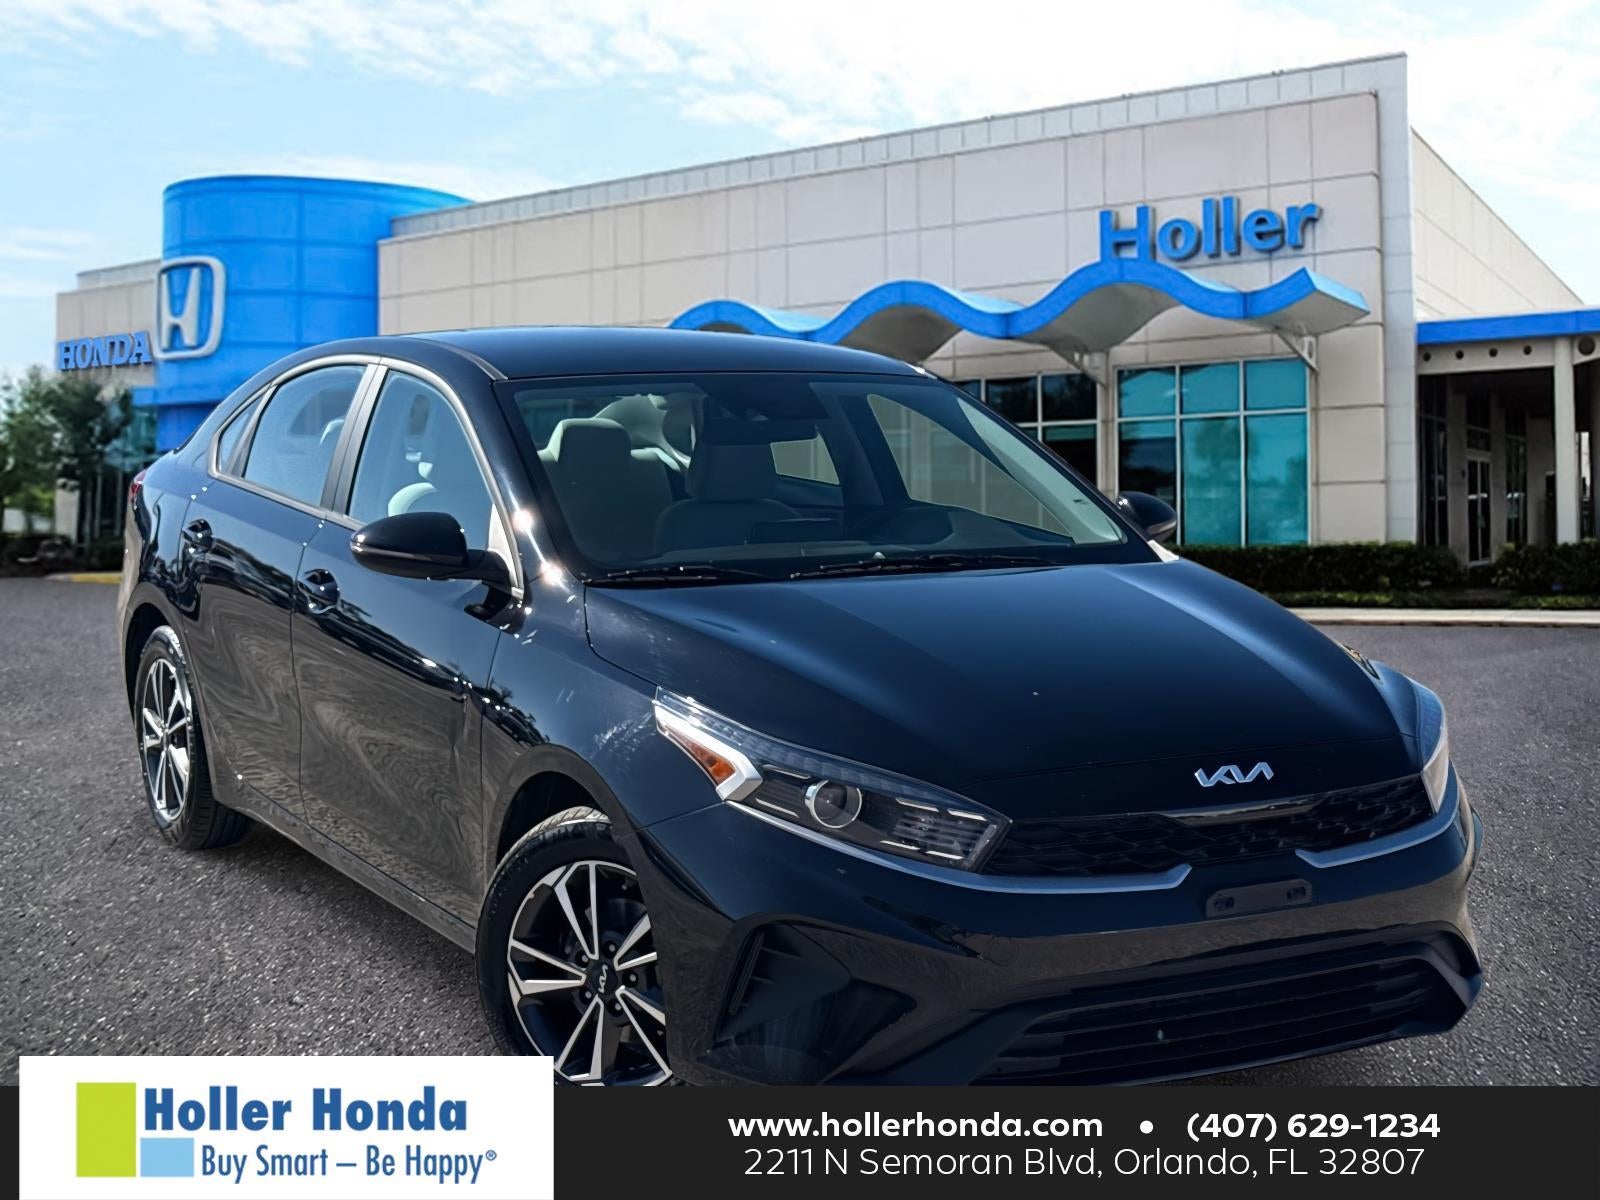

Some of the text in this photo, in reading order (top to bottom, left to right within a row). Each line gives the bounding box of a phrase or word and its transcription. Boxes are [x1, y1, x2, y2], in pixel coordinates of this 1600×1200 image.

[1099, 195, 1321, 261] Holler
[57, 330, 152, 371] HONDA
[1194, 761, 1275, 787] KIA
